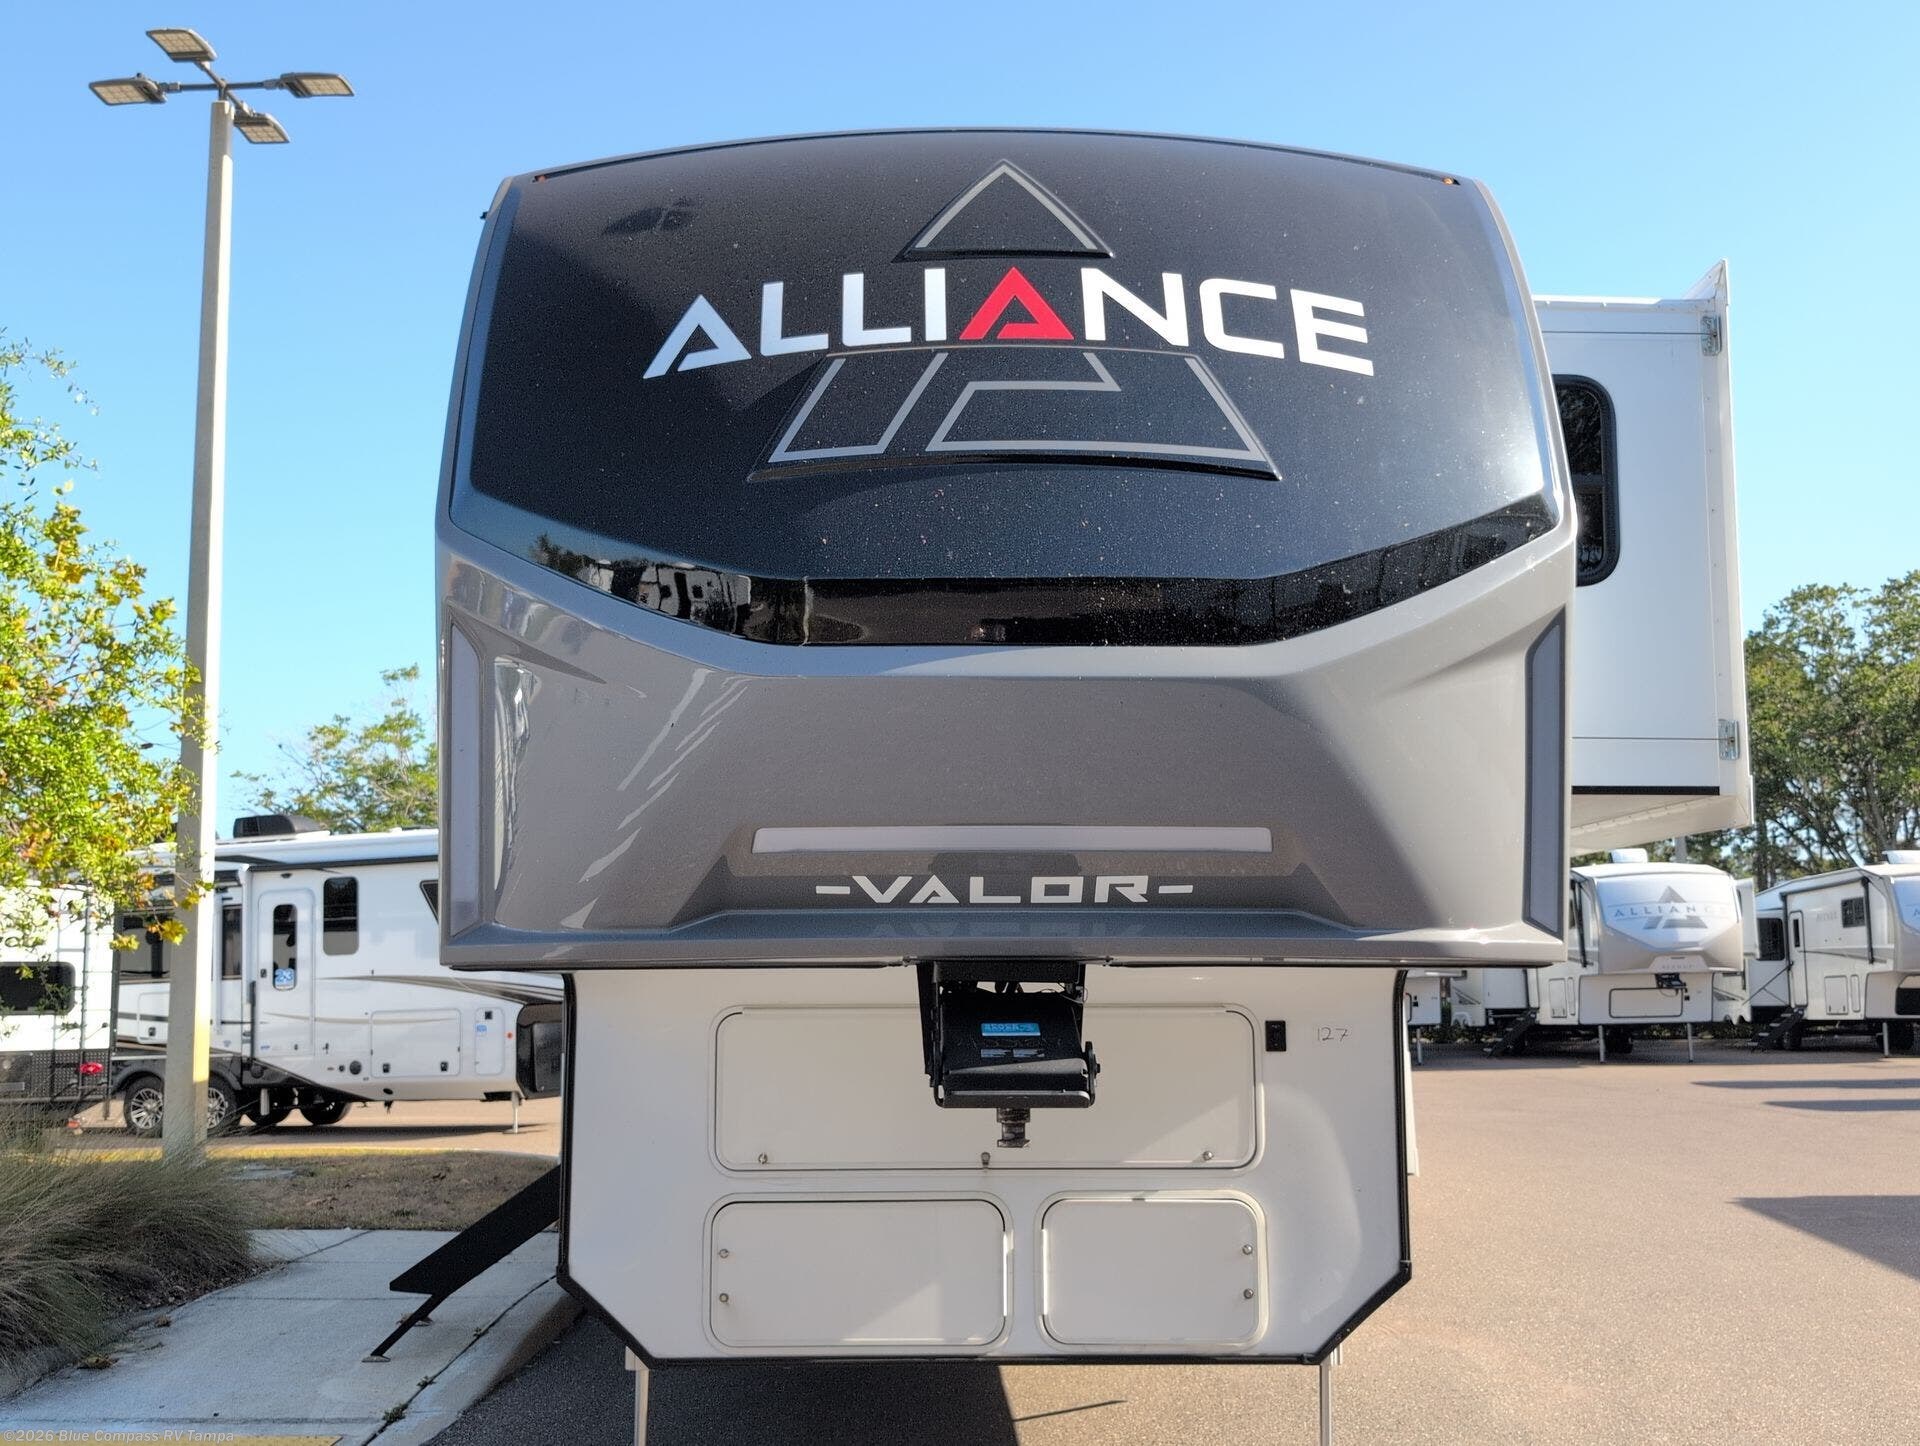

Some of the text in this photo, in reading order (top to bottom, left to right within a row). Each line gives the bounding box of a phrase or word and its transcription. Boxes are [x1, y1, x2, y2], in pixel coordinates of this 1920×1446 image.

[643, 266, 1375, 379] ALLIANCE
[1614, 905, 1729, 918] ALLIANC
[1317, 1026, 1348, 1042] 127
